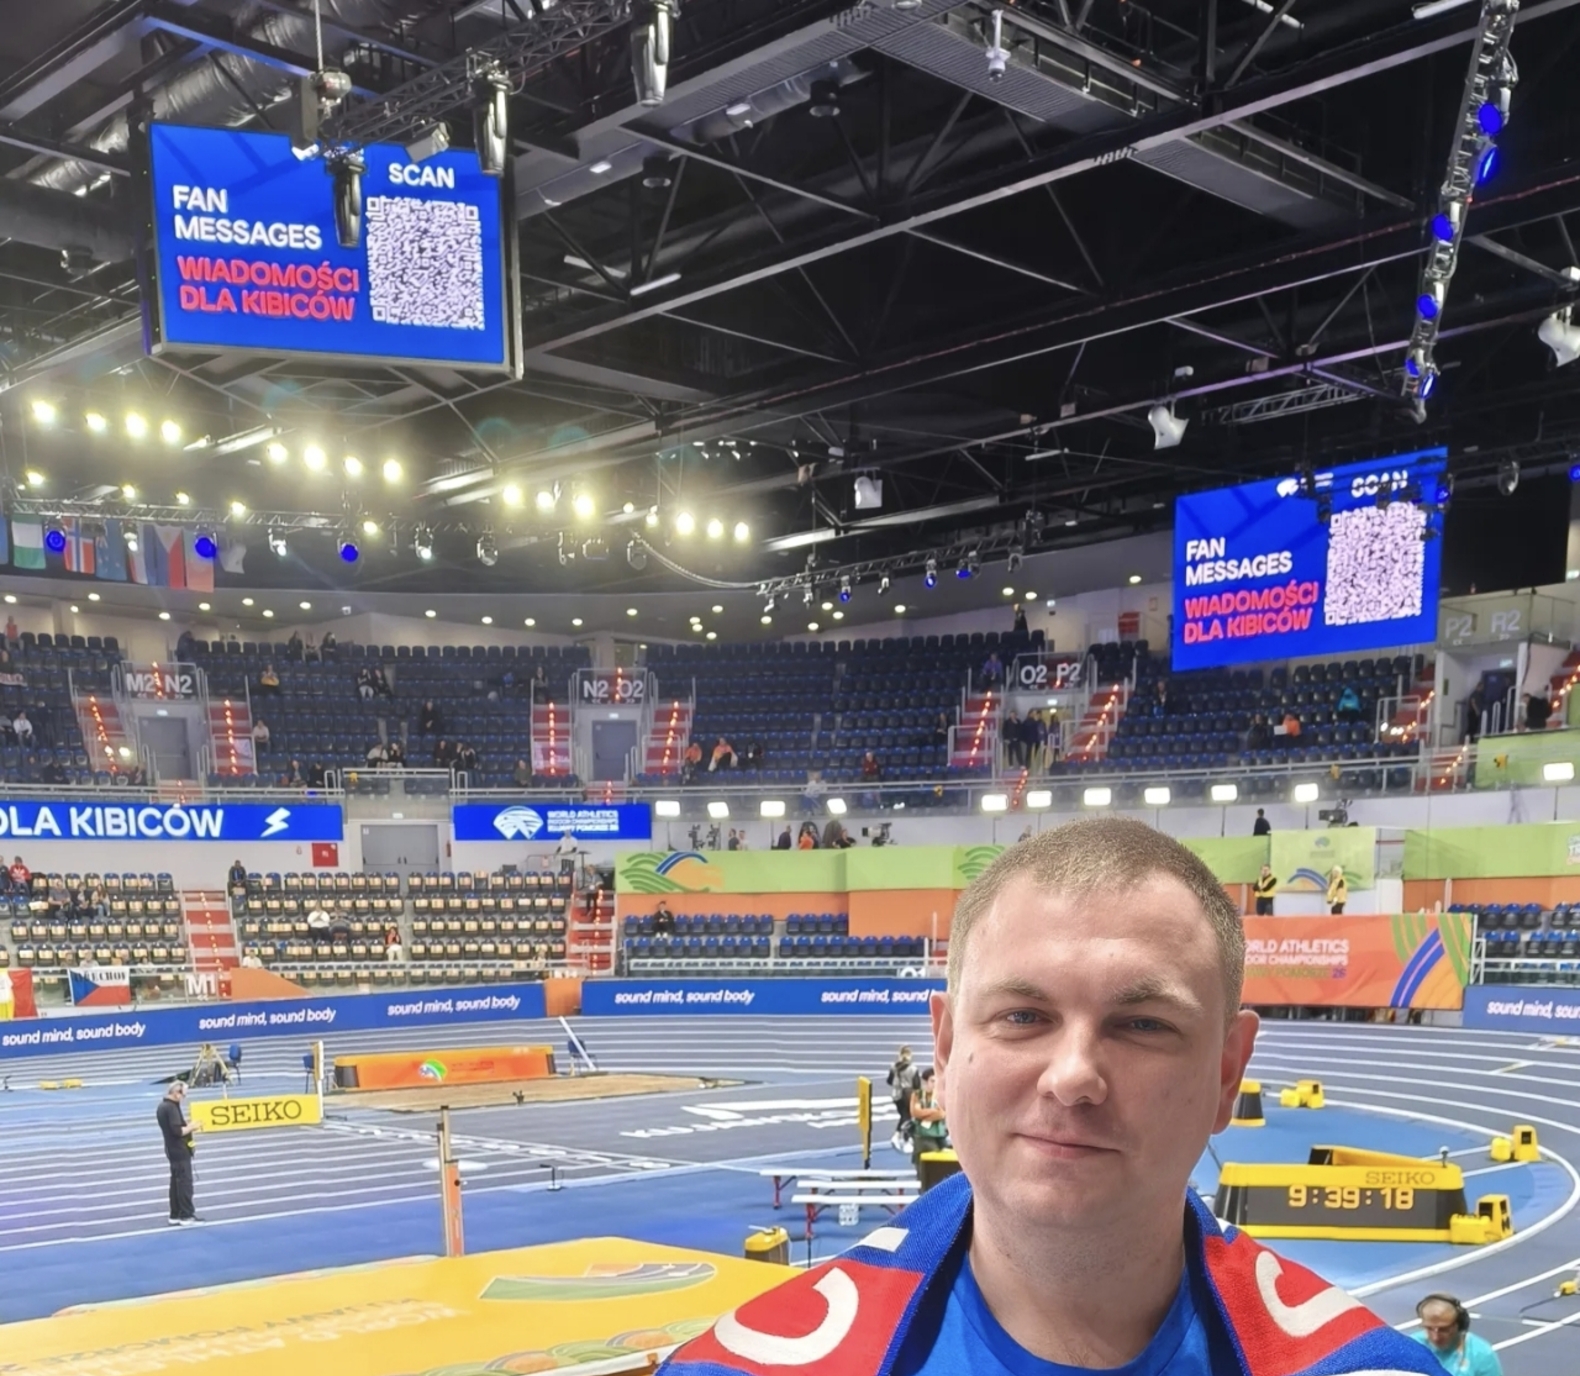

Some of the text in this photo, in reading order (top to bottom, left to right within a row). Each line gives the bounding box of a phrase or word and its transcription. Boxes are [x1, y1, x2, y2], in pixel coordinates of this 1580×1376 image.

[388, 163, 455, 189] SCAN
[173, 184, 228, 213] FAN
[173, 215, 323, 249] MESSAGES
[177, 256, 360, 292] WIADOMOŚCI
[179, 287, 237, 313] DLA
[242, 290, 355, 320] KIBICÓW
[1186, 537, 1225, 561] FAN
[1186, 552, 1293, 586] MESSAGES
[1185, 580, 1318, 619] WIADOMOŚCI
[1184, 617, 1223, 644] DLA
[1227, 607, 1313, 638] KIBICÓW
[1445, 615, 1473, 639] P2
[126, 672, 157, 692] M2
[165, 674, 193, 694] N2
[1020, 665, 1047, 684] O2
[1057, 663, 1081, 684] P2
[583, 680, 609, 698] N2
[618, 680, 643, 698] O2
[69, 803, 224, 837] KIBICÓW
[1280, 939, 1349, 953] ATHLETICS
[186, 974, 216, 995] M1
[821, 988, 929, 1004] sound mind, sound
[387, 994, 521, 1016] sound mind, sound body
[615, 989, 755, 1006] sound mind, sound body
[1487, 999, 1523, 1015] sound
[199, 1007, 336, 1030] sound mind, sound body
[2, 1021, 146, 1046] sound mind, sound body
[211, 1099, 302, 1127] SEIKO
[1365, 1170, 1436, 1186] SEIKO
[1288, 1184, 1414, 1210] 9:39:18
